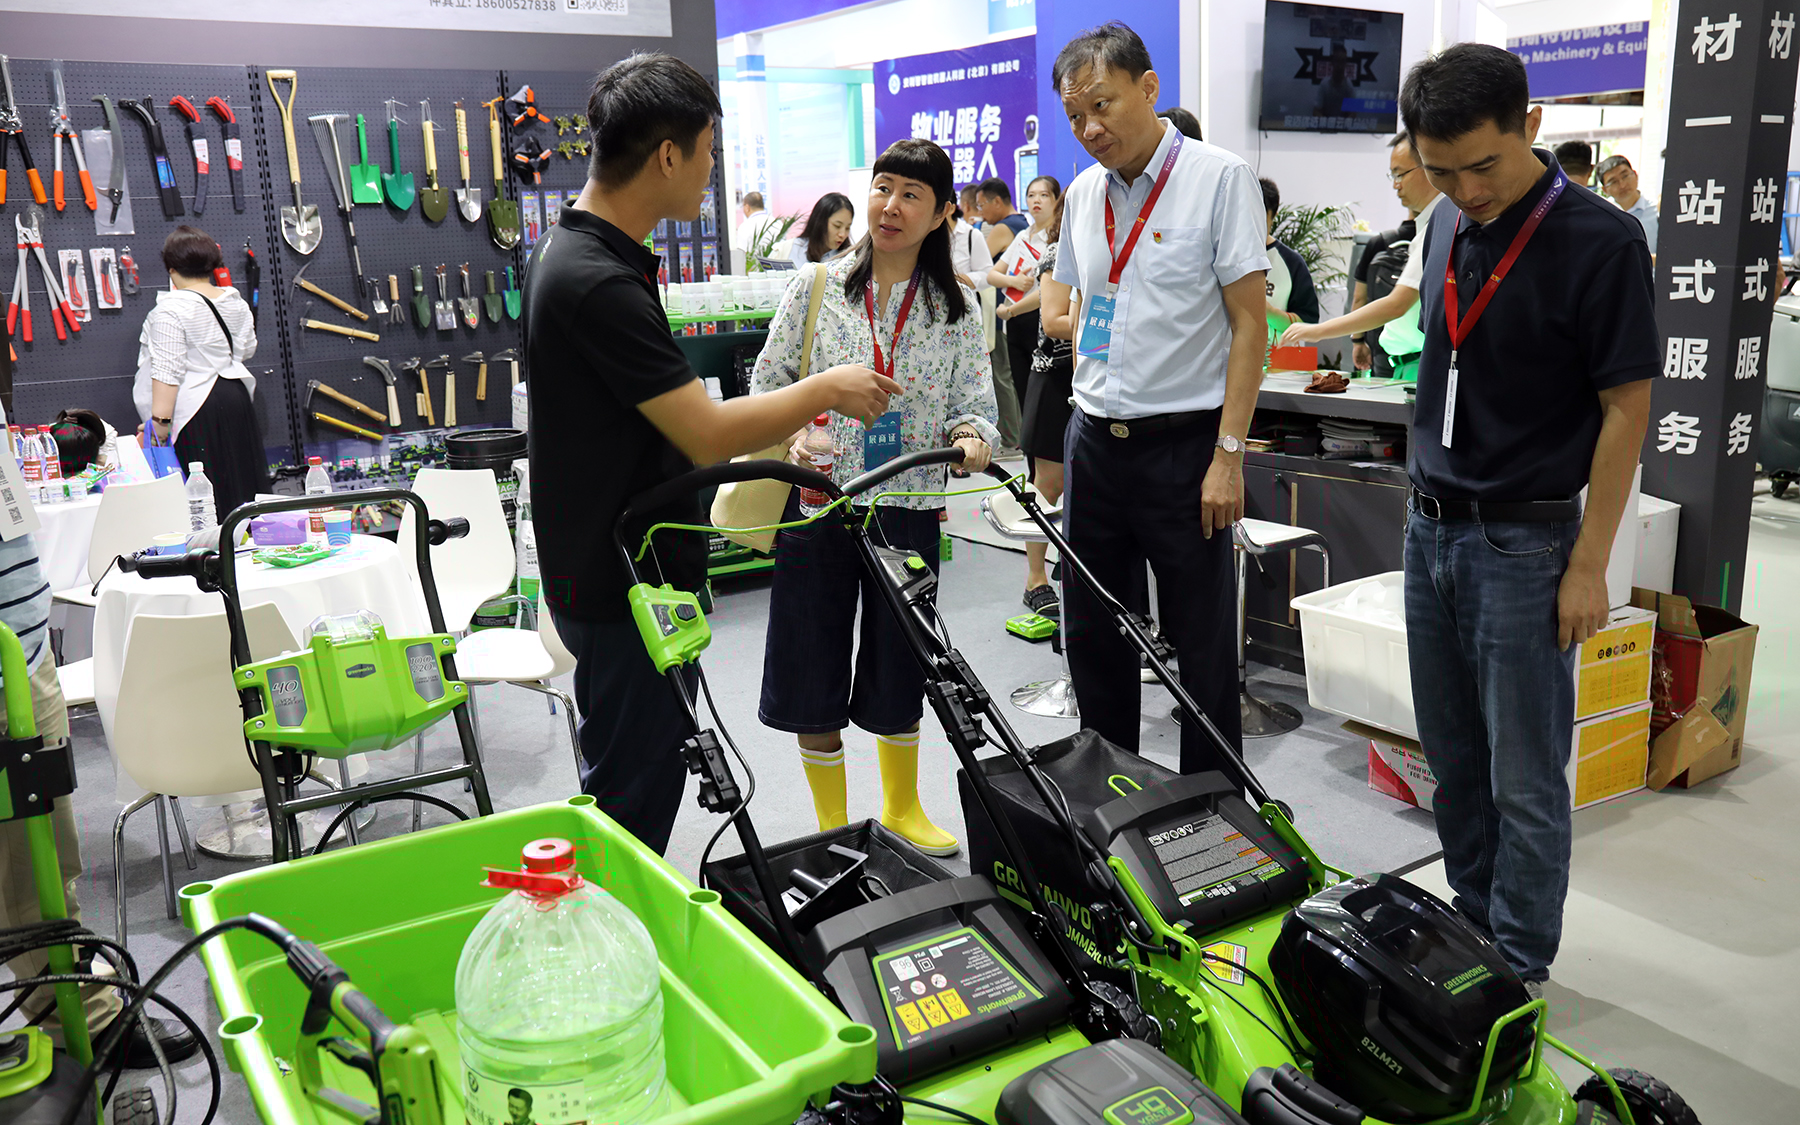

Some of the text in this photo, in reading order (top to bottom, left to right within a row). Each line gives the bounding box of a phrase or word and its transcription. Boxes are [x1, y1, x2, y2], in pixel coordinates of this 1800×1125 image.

[1532, 46, 1600, 63] Machinery
[1602, 42, 1614, 55] &
[911, 104, 1001, 147] 物业服务
[943, 144, 998, 184] 器人
[1657, 13, 1742, 455] 材一站式服务
[1727, 11, 1795, 456] 材一站式服务
[272, 680, 298, 695] 40
[898, 958, 912, 970] 96
[1443, 964, 1488, 990] GREENWORKS
[977, 988, 1027, 1014] greenworks
[1361, 1036, 1403, 1075] 82LM21
[1124, 1095, 1167, 1117] 40
